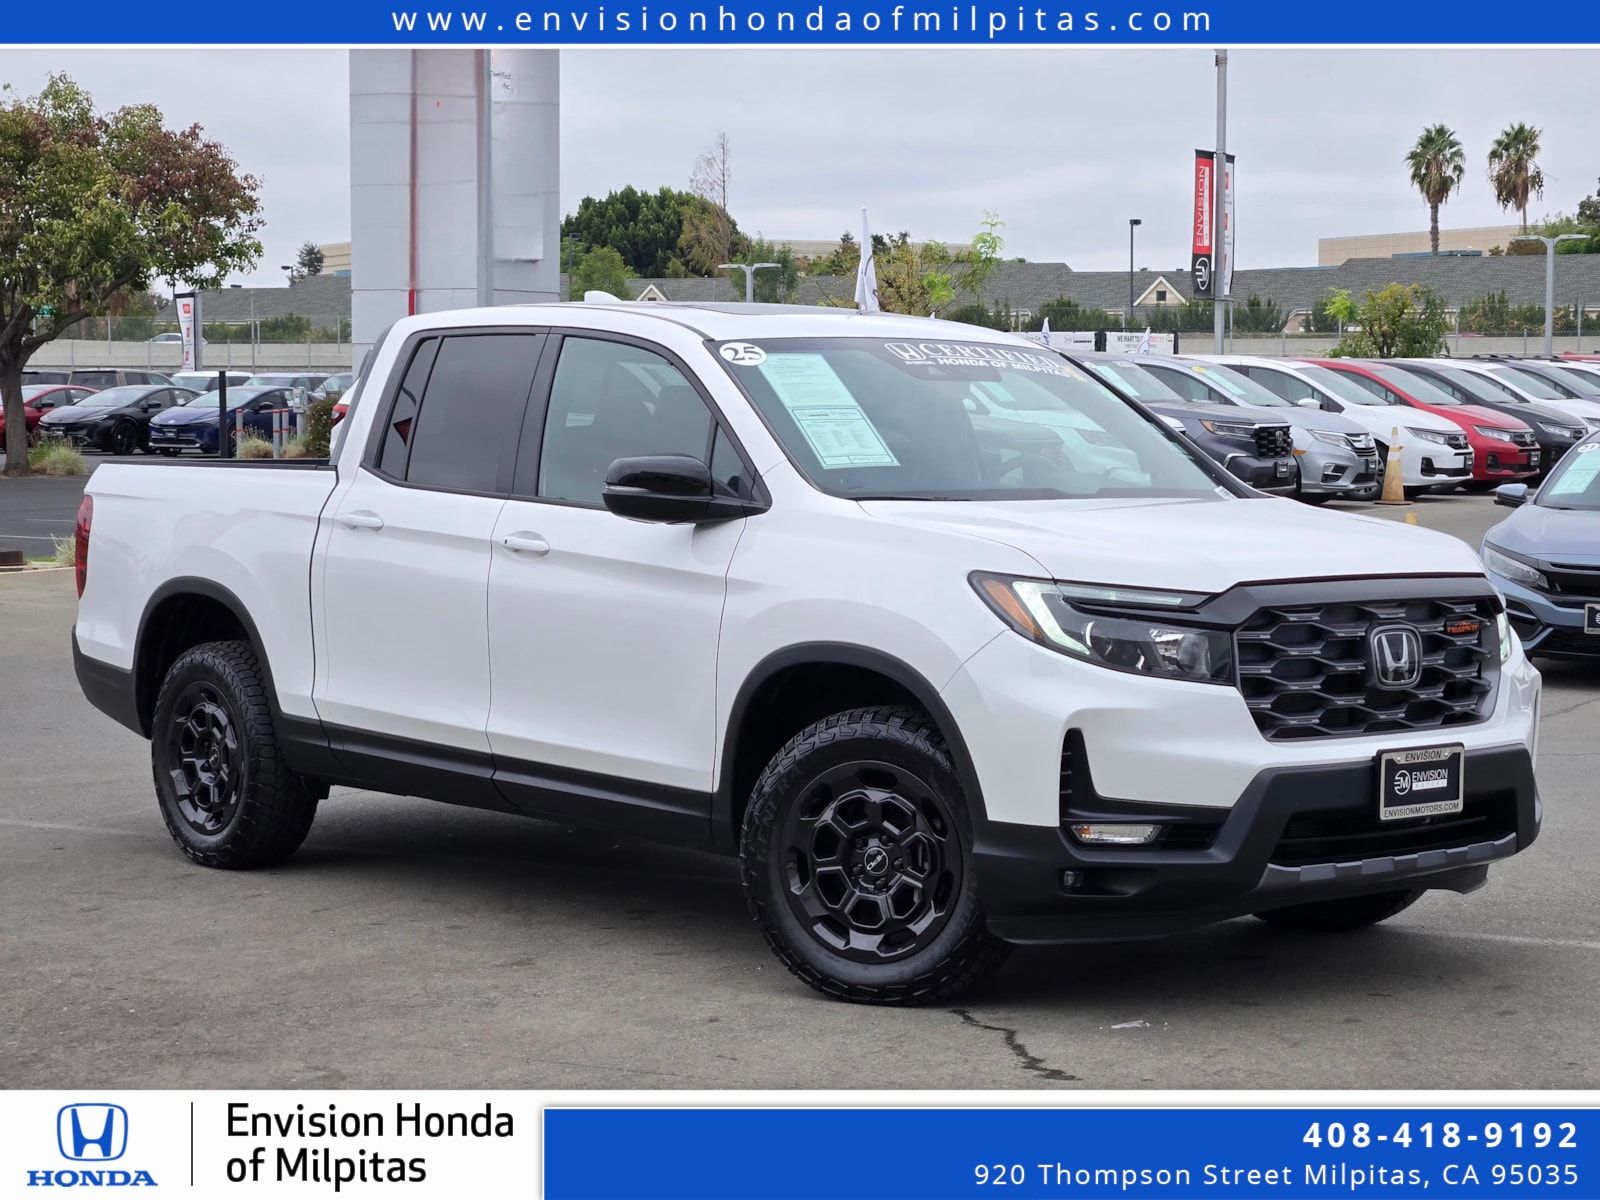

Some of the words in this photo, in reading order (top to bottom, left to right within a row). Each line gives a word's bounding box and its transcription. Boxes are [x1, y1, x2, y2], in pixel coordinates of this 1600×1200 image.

[1196, 165, 1205, 247] ENVISION
[723, 345, 764, 363] 25
[919, 343, 1059, 368] CERTIFIED
[937, 357, 989, 367] HONDA
[989, 360, 1009, 369] OF
[1011, 362, 1072, 379] MILPITAS
[1405, 749, 1442, 762] ENVISION
[1412, 768, 1449, 782] ENVISION
[1384, 802, 1460, 818] ENVISIONMOTORS.COM
